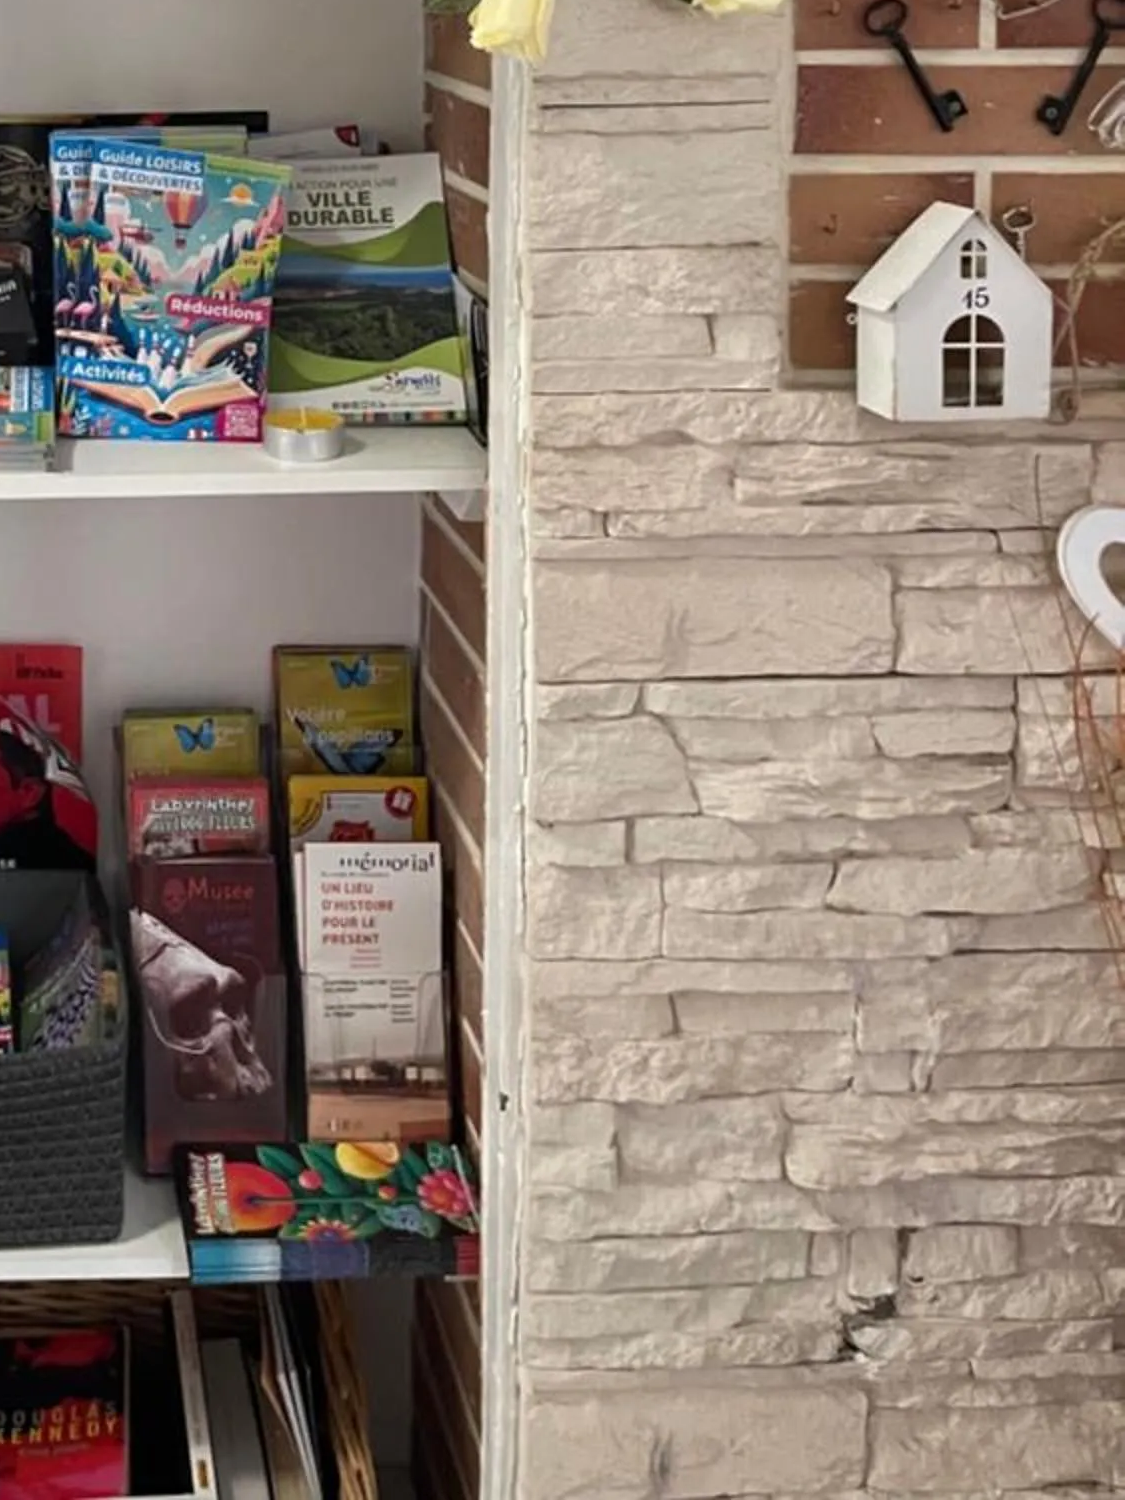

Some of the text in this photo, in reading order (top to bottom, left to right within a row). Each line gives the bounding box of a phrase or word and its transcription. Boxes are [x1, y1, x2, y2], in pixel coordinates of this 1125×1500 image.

[99, 149, 202, 175] Guide LOISIRS
[306, 191, 372, 208] VILLE
[287, 207, 395, 227] DURABLE
[961, 286, 990, 310] 15
[170, 297, 264, 323] Réductions
[73, 363, 146, 385] Activités
[339, 852, 436, 873] mémorial
[321, 882, 374, 895] UN LIEU
[321, 900, 394, 912] D'HISTOIRE
[322, 917, 375, 929] POUR LE
